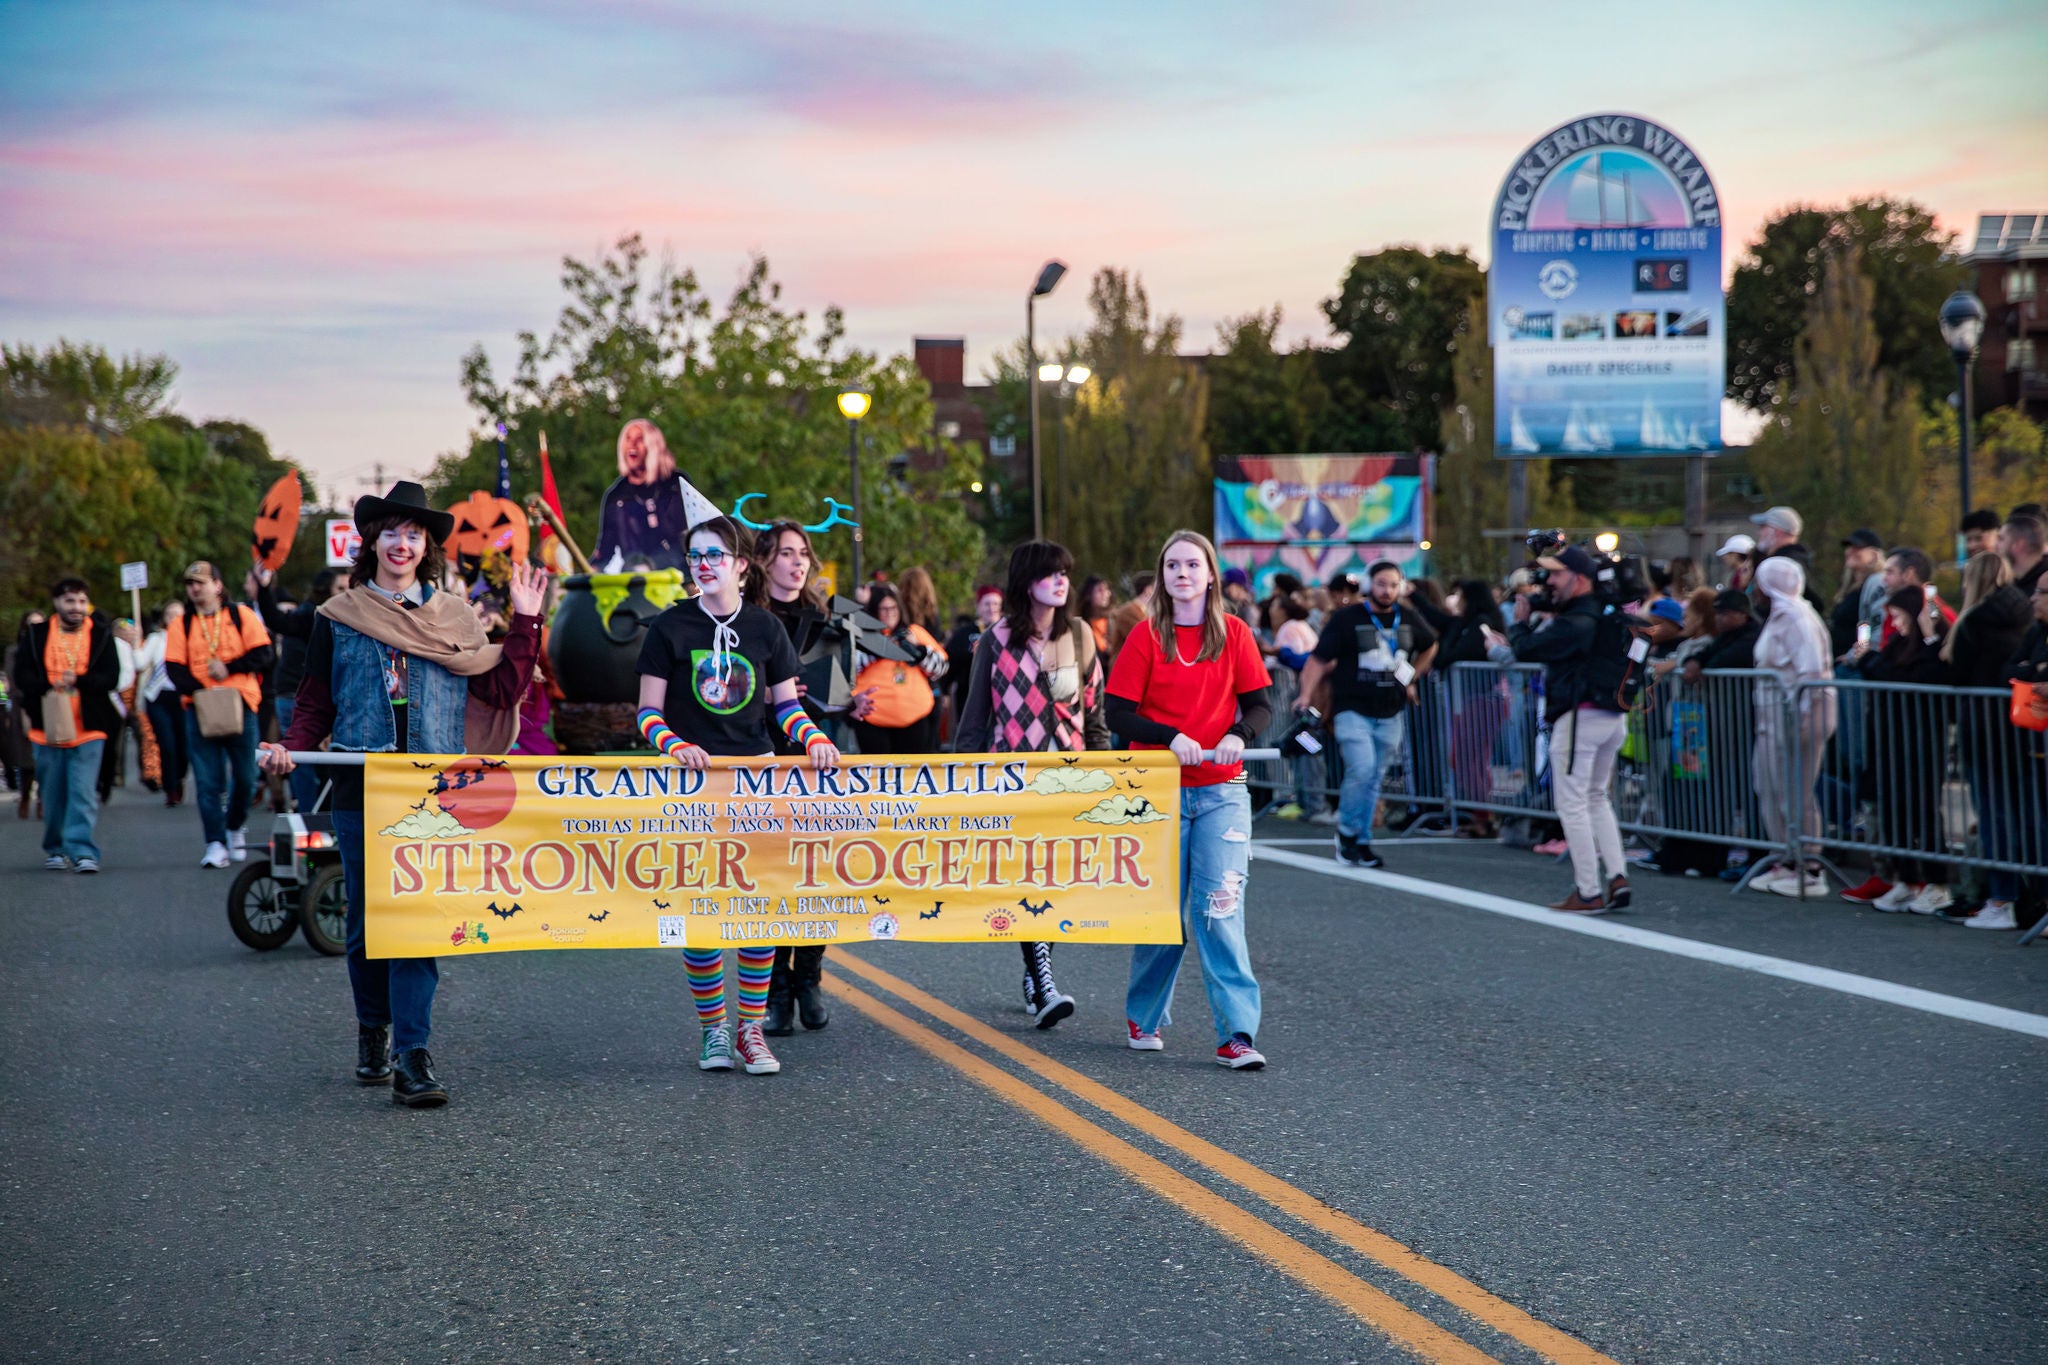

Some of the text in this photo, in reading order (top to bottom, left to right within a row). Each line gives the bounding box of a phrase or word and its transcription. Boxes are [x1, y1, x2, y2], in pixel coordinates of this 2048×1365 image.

[1500, 116, 1720, 230] PICKERING WHARF
[1598, 360, 1673, 376] SPECIALS
[536, 760, 1027, 798] GRAND MARSHALLS
[662, 801, 919, 817] OMRI KATZ VINESSA SHAW
[563, 815, 1015, 833] TOBIAS JELINEK JASON MARSDEN LARRY BAGBY
[392, 833, 1151, 897] STRONGER TOGETHER
[726, 896, 770, 916] JUST
[776, 897, 791, 915] A
[796, 895, 869, 915] BUNCHA
[720, 919, 838, 940] HALLOWEEN
